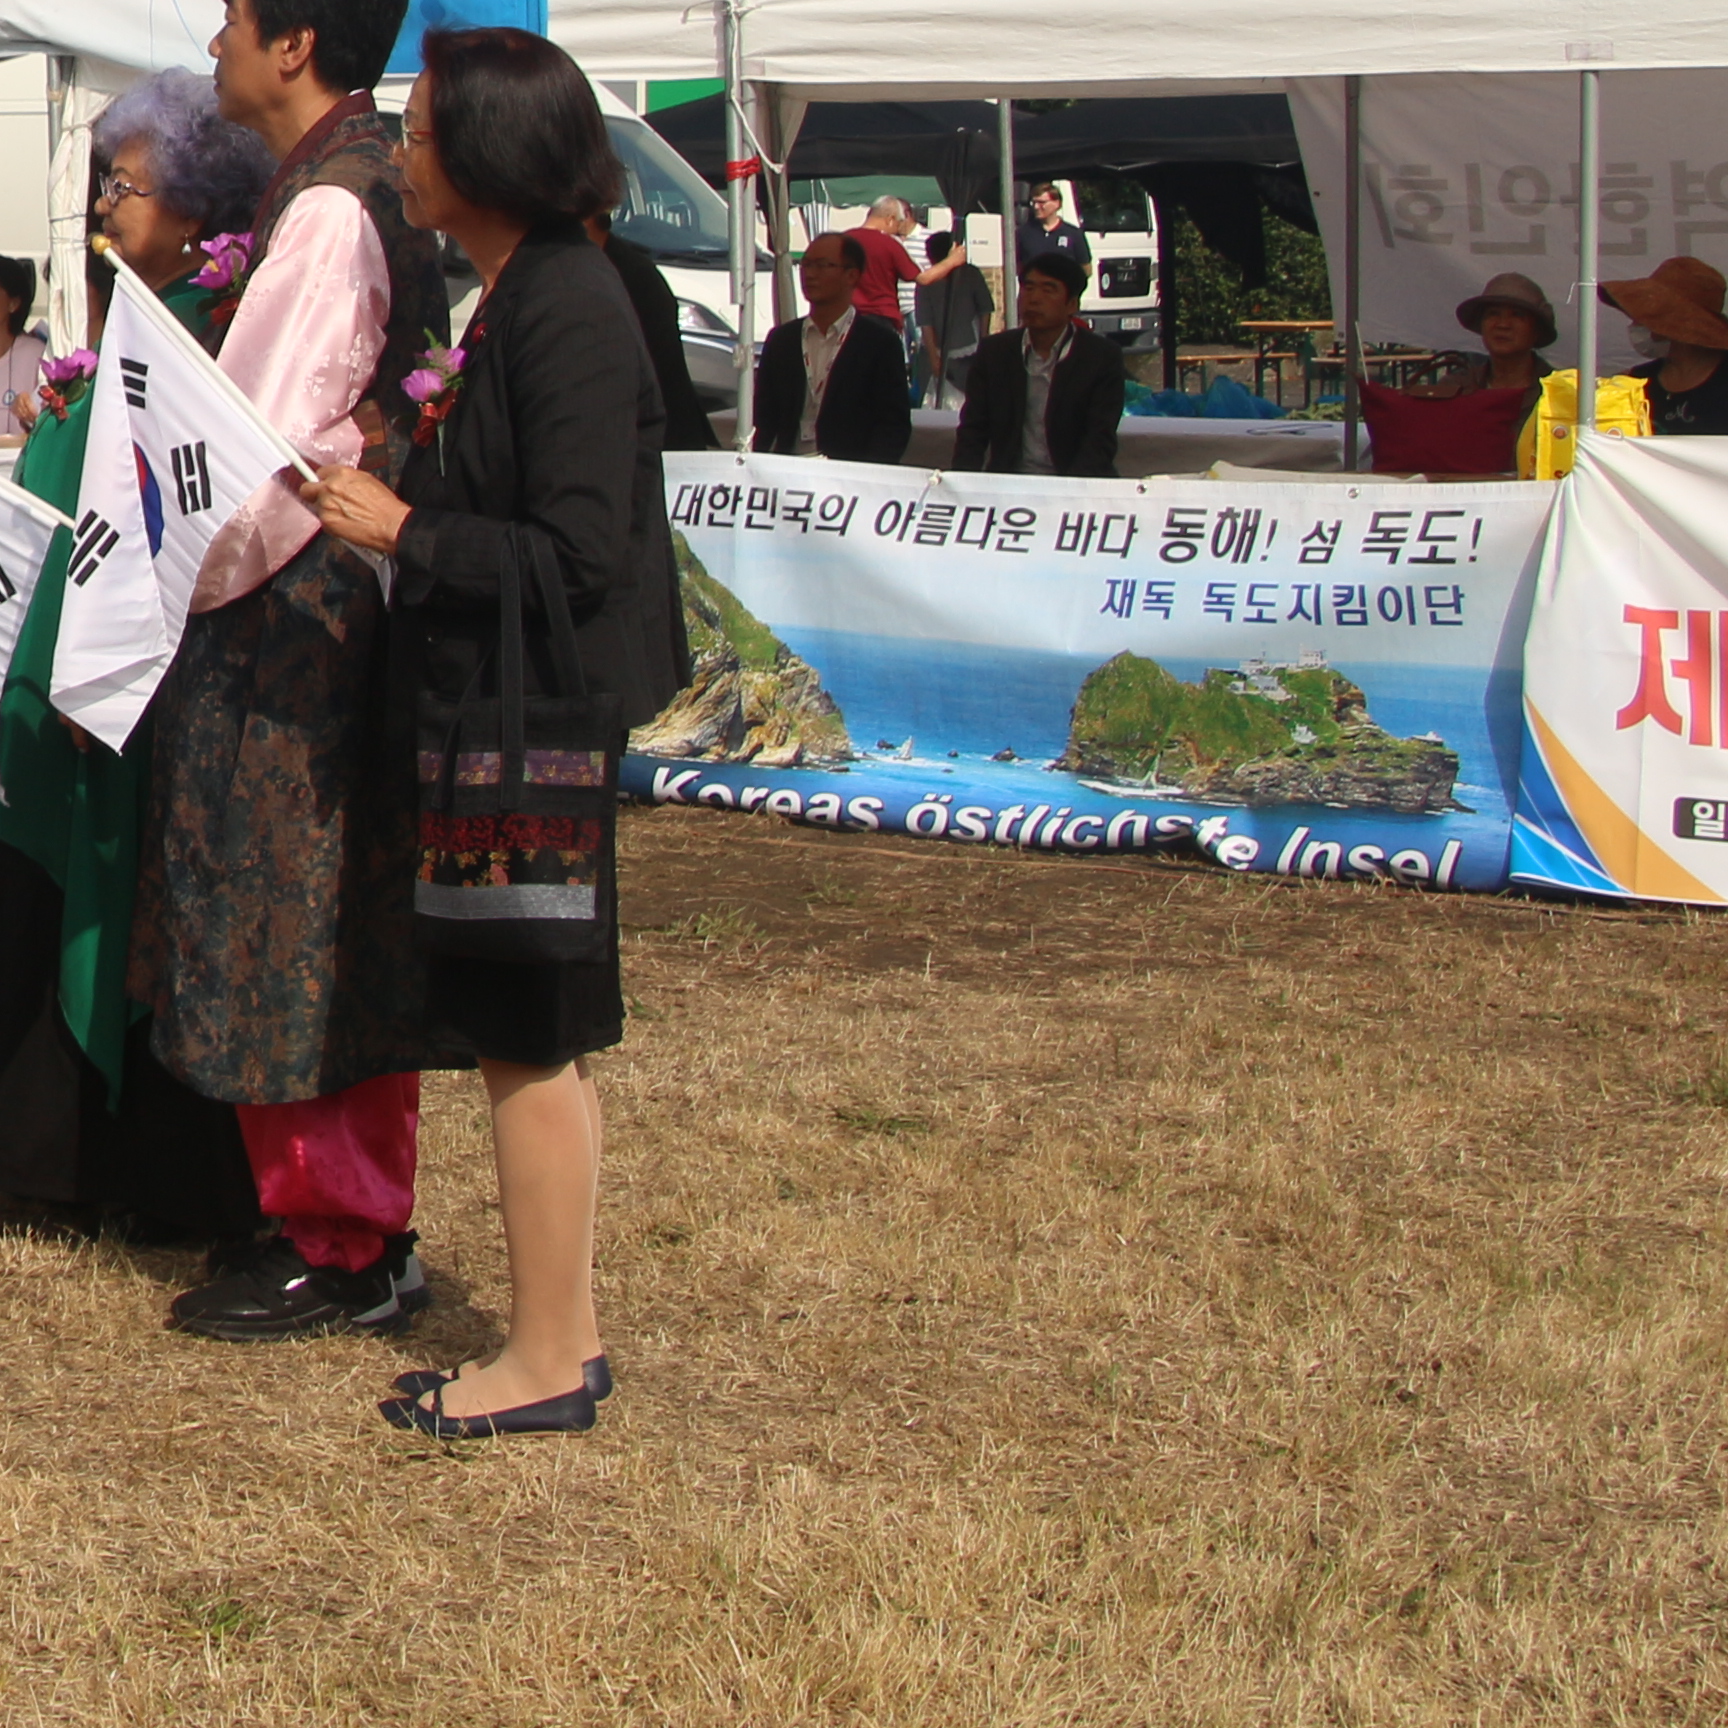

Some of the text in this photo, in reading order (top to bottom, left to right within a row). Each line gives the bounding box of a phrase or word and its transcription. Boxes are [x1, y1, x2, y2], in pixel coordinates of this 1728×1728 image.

[670, 482, 1482, 566] 대한민국의 아름다운 바다 동해! 섬 독도!
[1098, 576, 1465, 627] 재독 독도지킴이단
[1276, 825, 1464, 890] Insel
